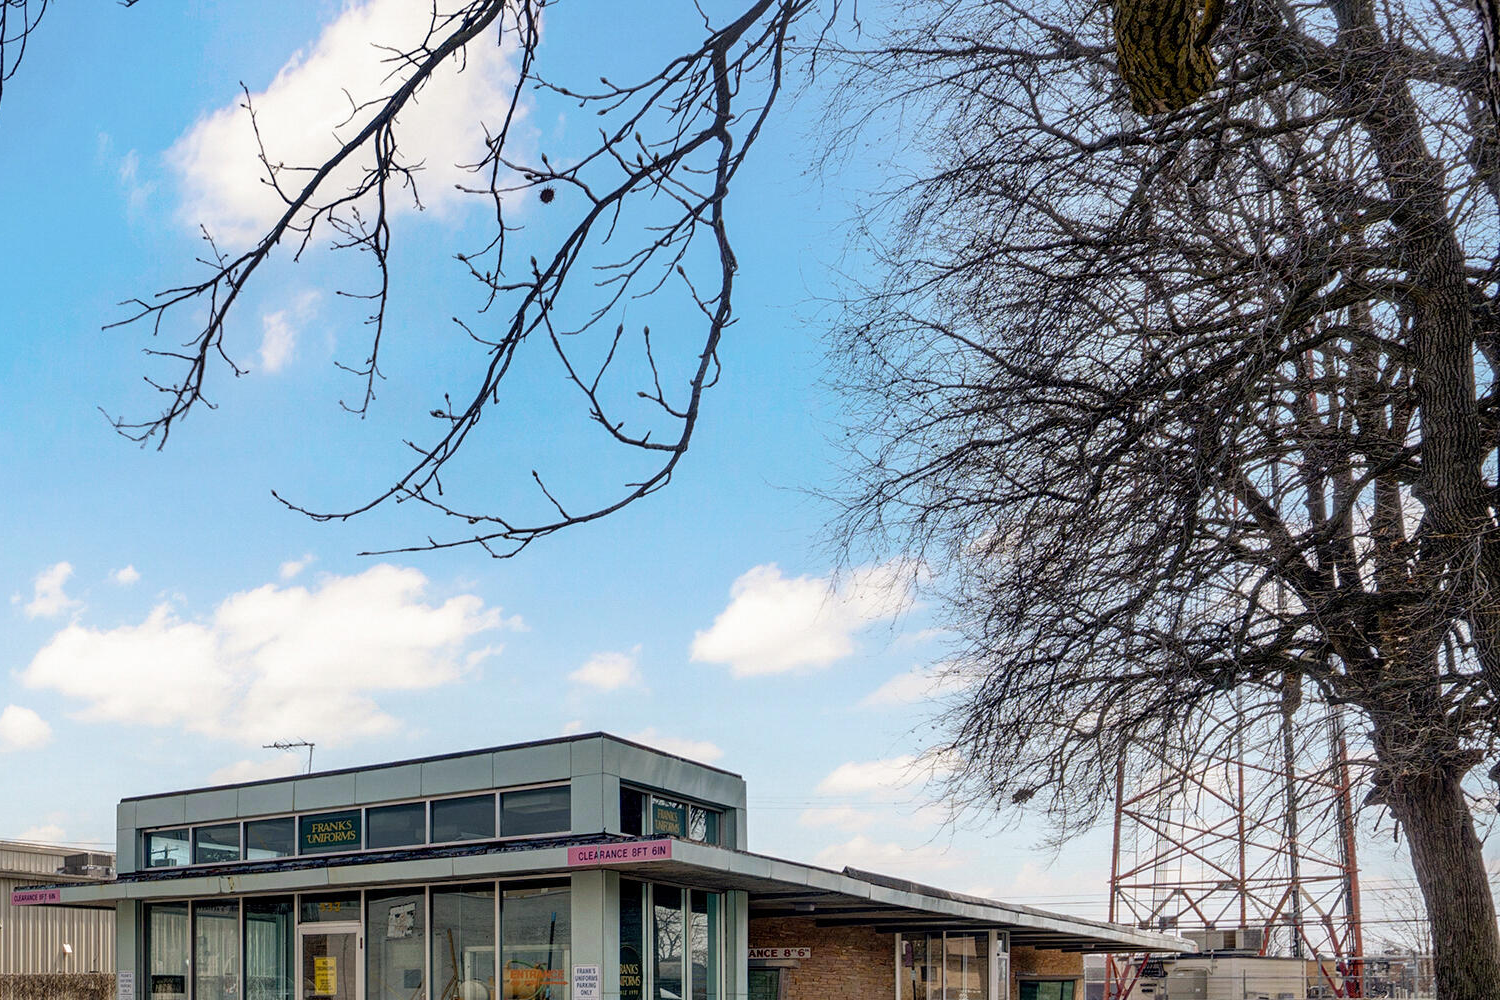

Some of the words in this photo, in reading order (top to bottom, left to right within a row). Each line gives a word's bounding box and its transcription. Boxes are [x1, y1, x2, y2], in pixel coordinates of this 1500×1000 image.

[306, 830, 357, 844] UNIFORMS
[578, 848, 627, 861] CLEARANCE
[631, 847, 648, 857] 8FT
[652, 845, 666, 856] 6IN
[14, 894, 38, 902] CLEARANCE
[510, 969, 565, 979] ENTRANCE
